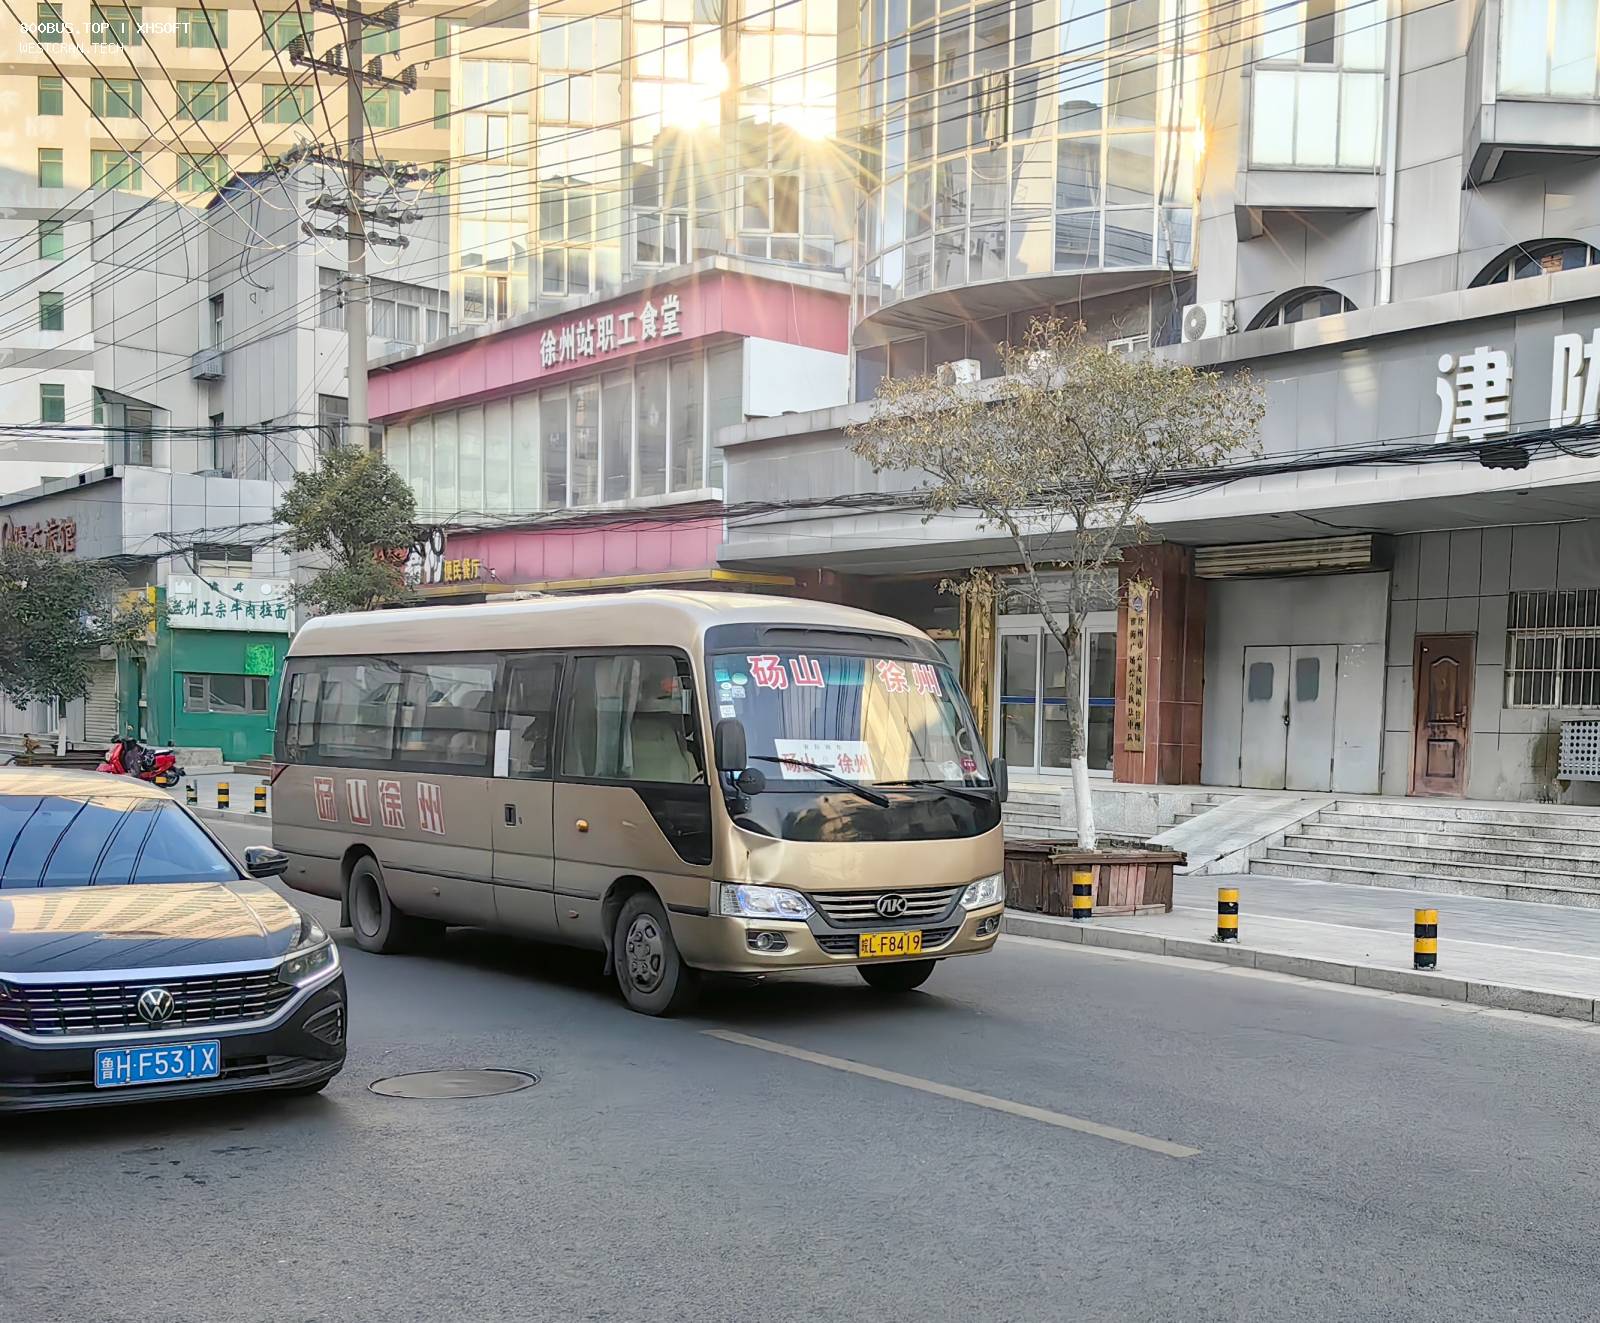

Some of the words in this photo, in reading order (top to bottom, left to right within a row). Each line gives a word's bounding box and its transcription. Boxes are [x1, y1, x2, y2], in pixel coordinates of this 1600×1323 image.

[540, 294, 682, 367] 徐州站职工食堂
[168, 597, 288, 621] 兰州正宗牛肉拉面
[747, 654, 825, 690] 砀山
[876, 659, 943, 697] 徐州
